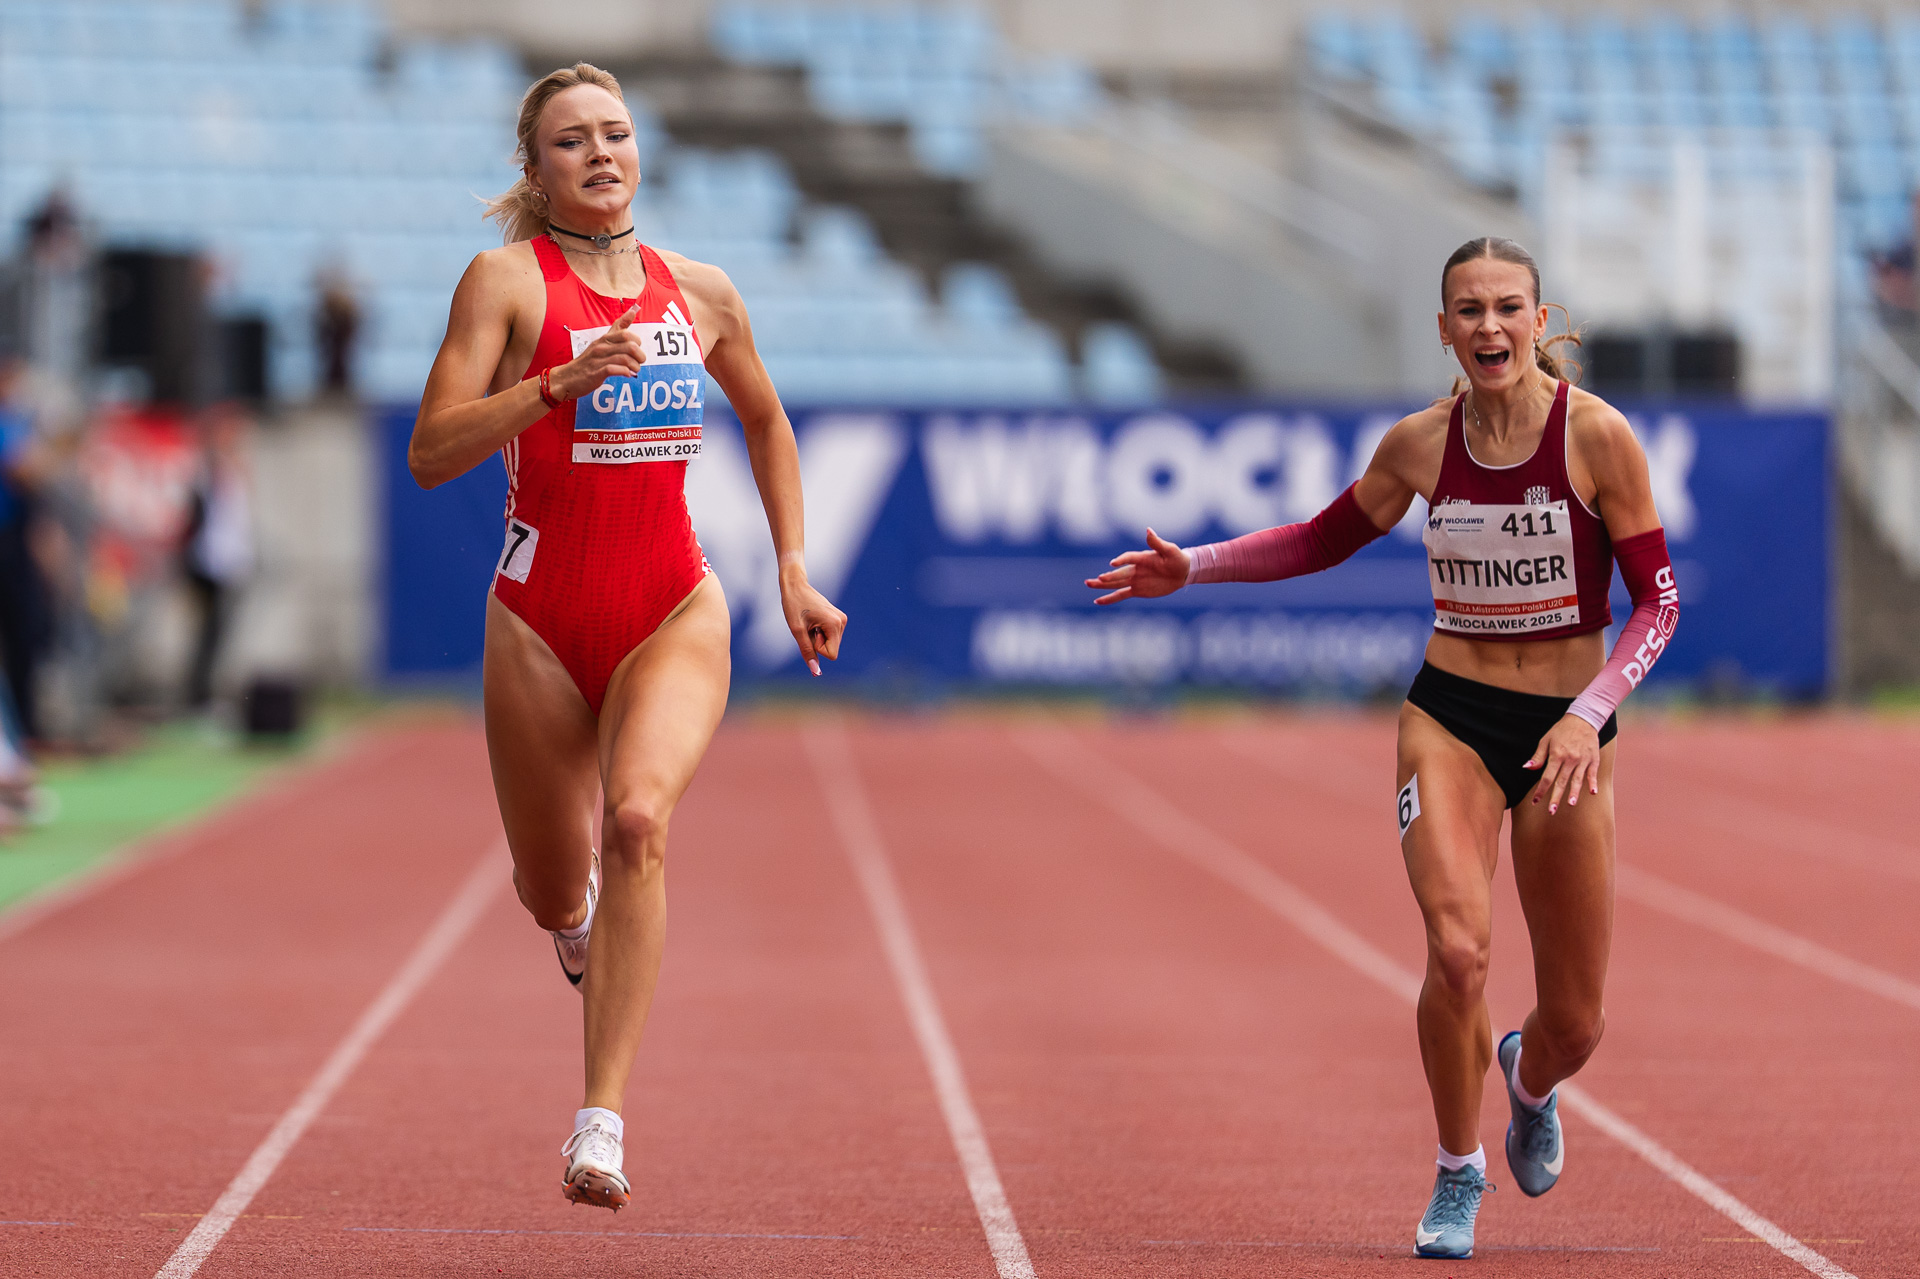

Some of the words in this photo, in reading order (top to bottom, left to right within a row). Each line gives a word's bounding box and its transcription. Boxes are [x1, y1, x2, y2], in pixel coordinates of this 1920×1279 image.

[653, 330, 688, 357] 157
[592, 379, 702, 414] GAJOSZ
[588, 433, 601, 441] 79.
[603, 434, 623, 442] PZLA
[624, 432, 666, 441] Mistrzostwa
[667, 429, 692, 438] Polski
[693, 428, 702, 437] U2
[590, 446, 671, 459] WŁOCŁAWEK
[1501, 511, 1557, 537] 411
[502, 522, 530, 571] 7
[1431, 554, 1568, 588] TITTINGER
[1455, 602, 1471, 612] PZLA
[1472, 605, 1521, 614] Mistrzostwa
[1522, 601, 1547, 612] Polski
[1548, 599, 1564, 608] U20
[1448, 616, 1527, 629] WŁOCŁAWEK
[1530, 613, 1563, 627] 2025
[1399, 787, 1411, 829] 6
